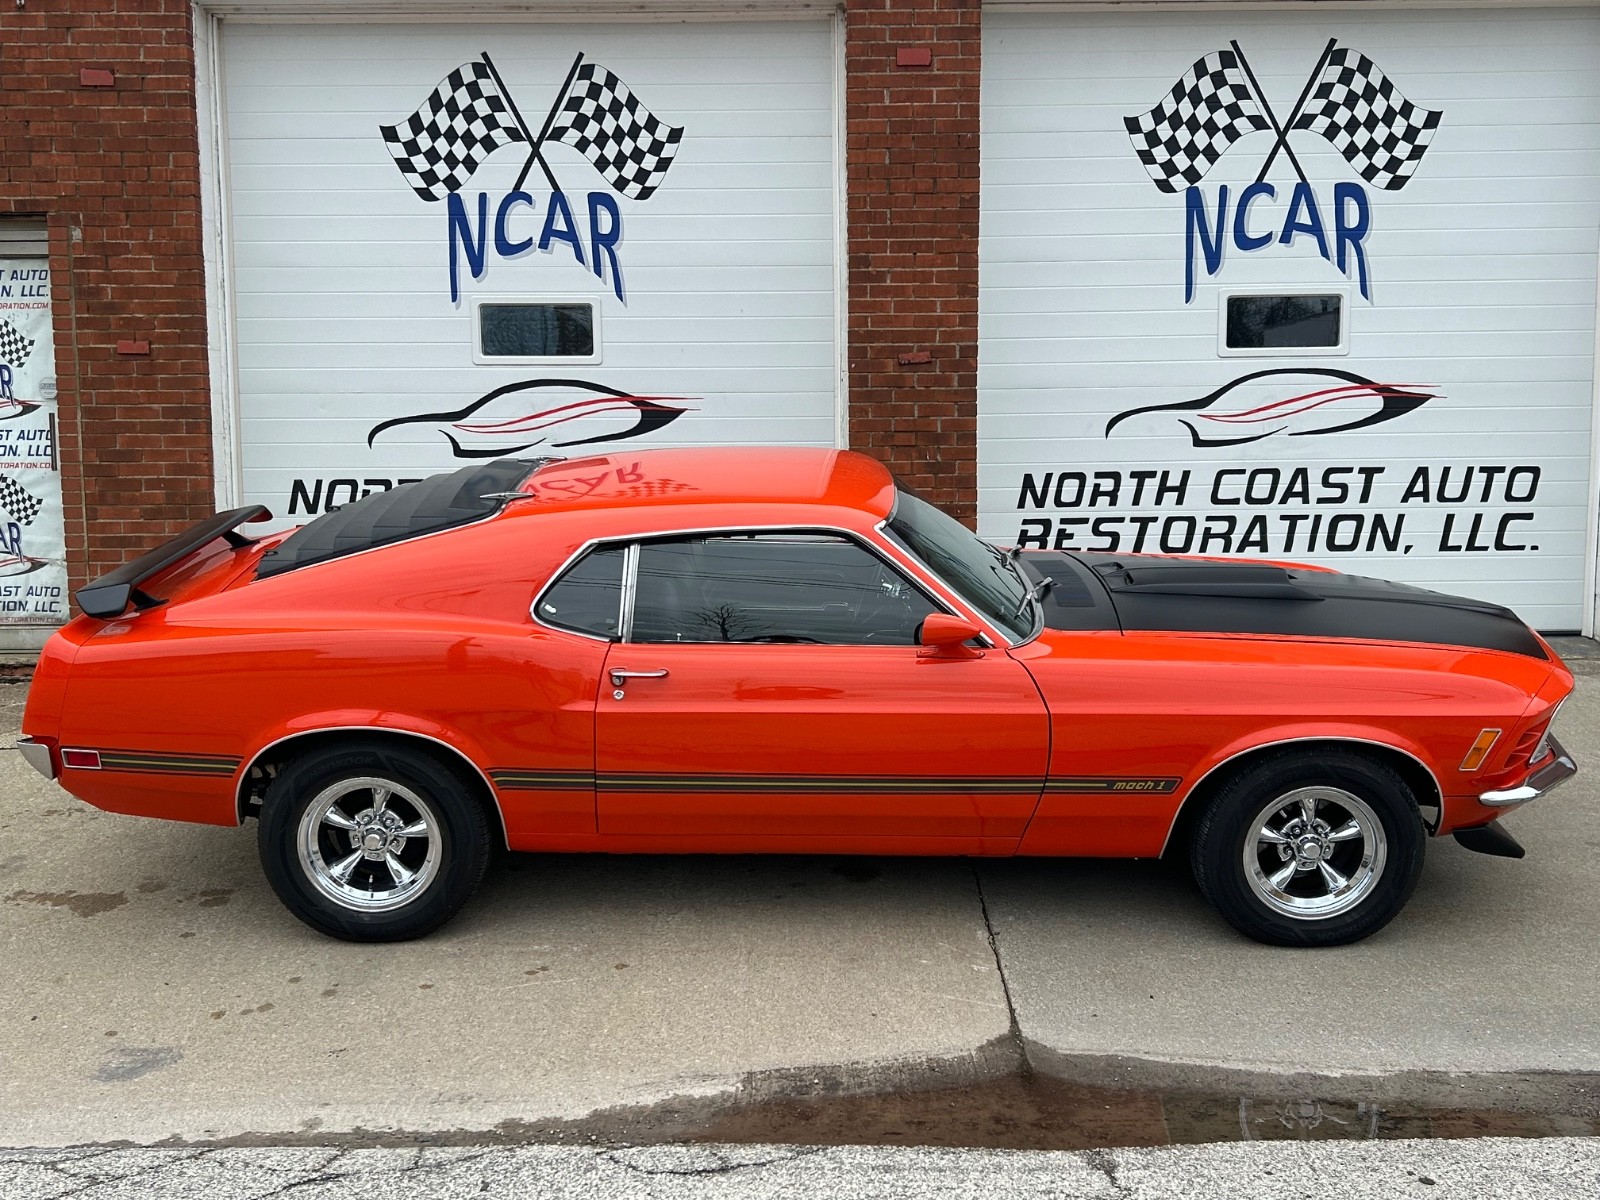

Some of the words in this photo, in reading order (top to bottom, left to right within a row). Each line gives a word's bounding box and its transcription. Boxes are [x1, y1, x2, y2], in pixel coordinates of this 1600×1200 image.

[447, 190, 624, 304] NCAR
[1185, 182, 1370, 304] NCAR
[10, 269, 48, 281] AUTO
[21, 285, 49, 297] LLC.
[1017, 470, 1191, 509] NORTH
[1210, 467, 1386, 505] COAST
[1400, 466, 1541, 503] AUTO
[1018, 514, 1413, 555] RESTORATION,
[1438, 513, 1539, 552] LLC.
[26, 586, 61, 597] AUTO
[34, 601, 62, 613] LLC.
[1113, 781, 1155, 790] mach
[1156, 781, 1165, 790] 1
